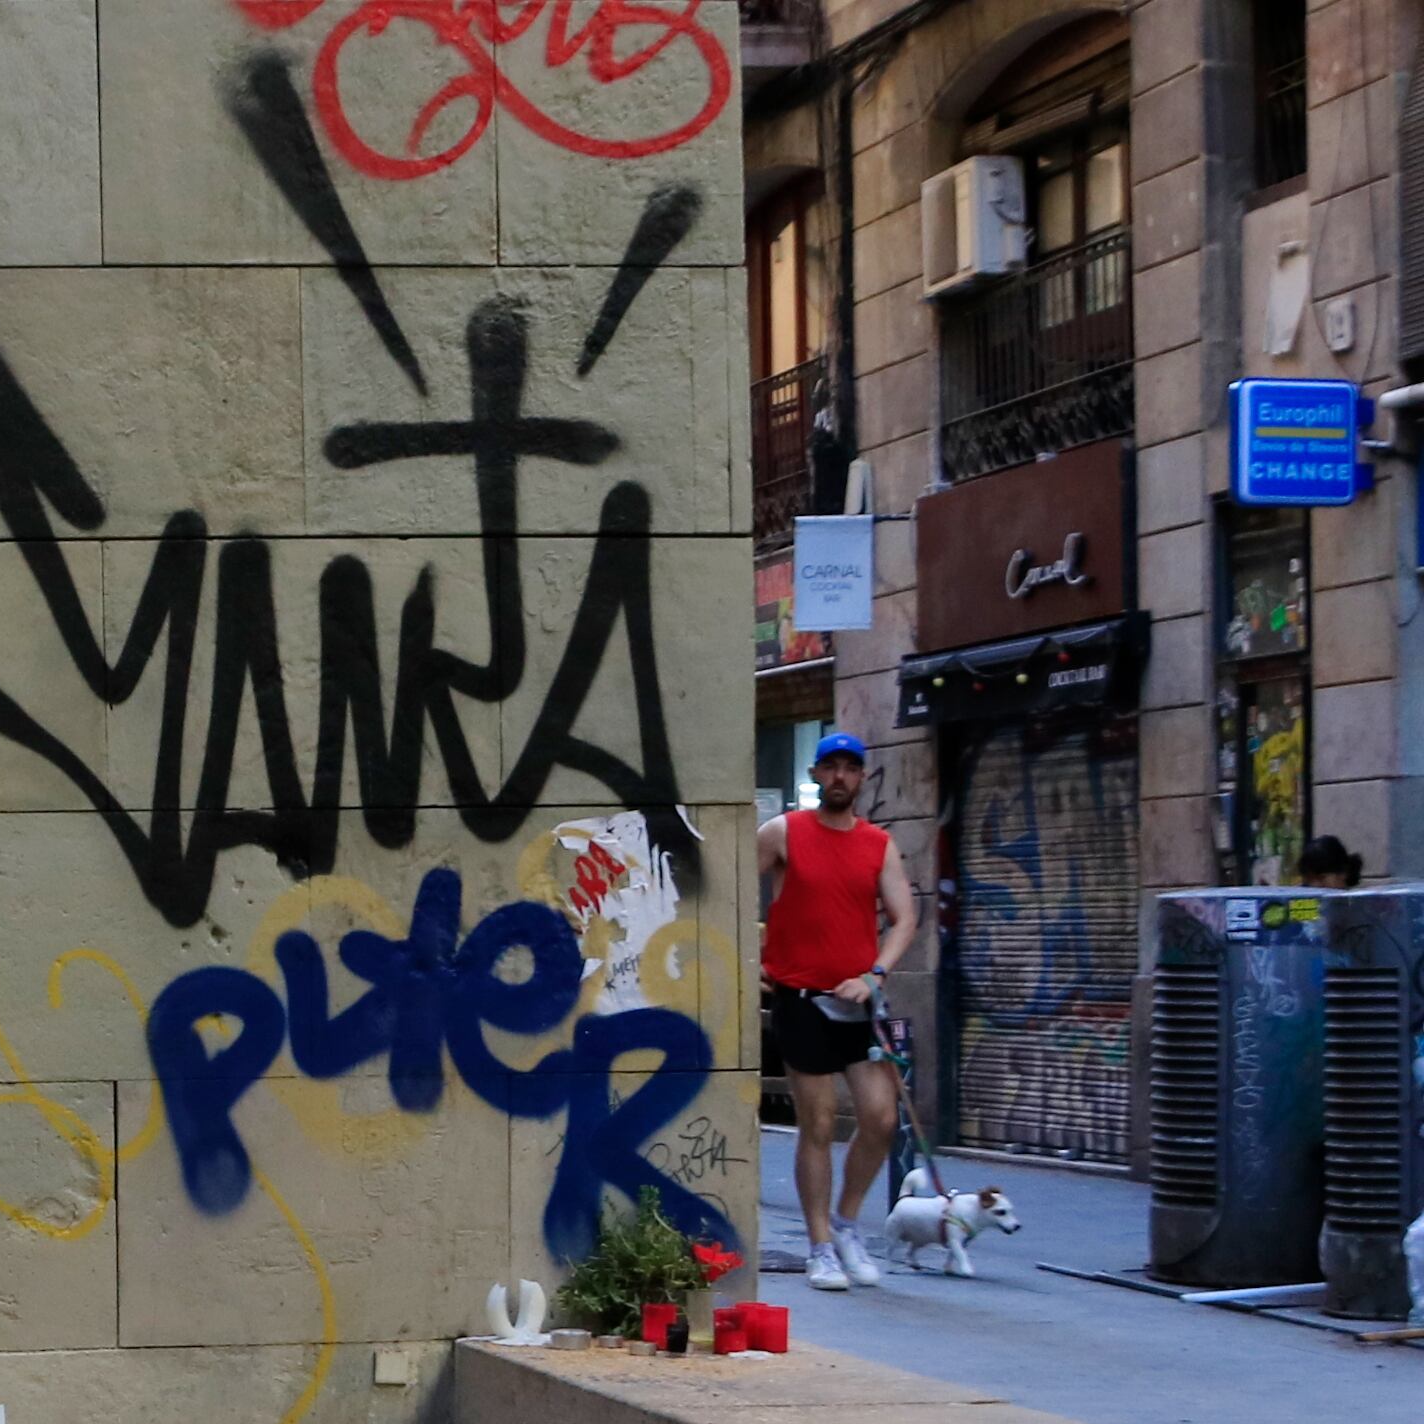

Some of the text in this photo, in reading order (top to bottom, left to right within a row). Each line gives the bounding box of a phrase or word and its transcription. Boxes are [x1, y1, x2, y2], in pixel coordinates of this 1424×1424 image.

[1259, 403, 1343, 427] Europhil
[1250, 462, 1351, 480] CHANGE
[800, 564, 863, 579] CARNAL
